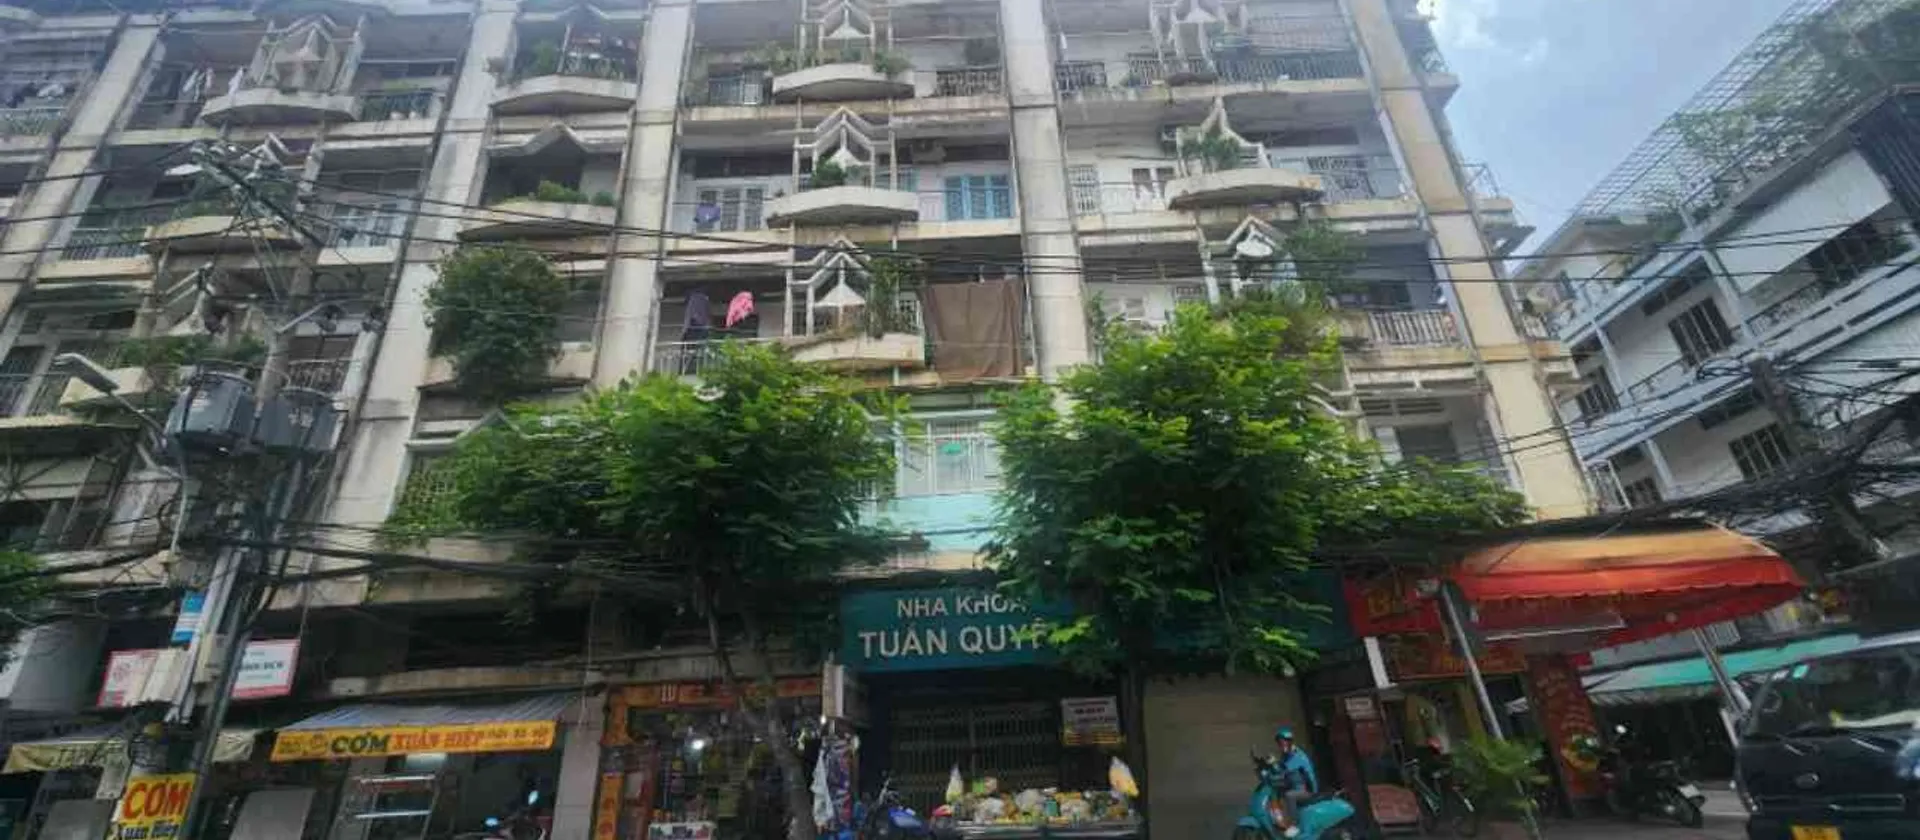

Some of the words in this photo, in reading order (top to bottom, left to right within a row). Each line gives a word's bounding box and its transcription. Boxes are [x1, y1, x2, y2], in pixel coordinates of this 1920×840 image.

[896, 596, 948, 618] NHA
[331, 731, 389, 754] CƠM
[123, 776, 193, 820] CƠM
